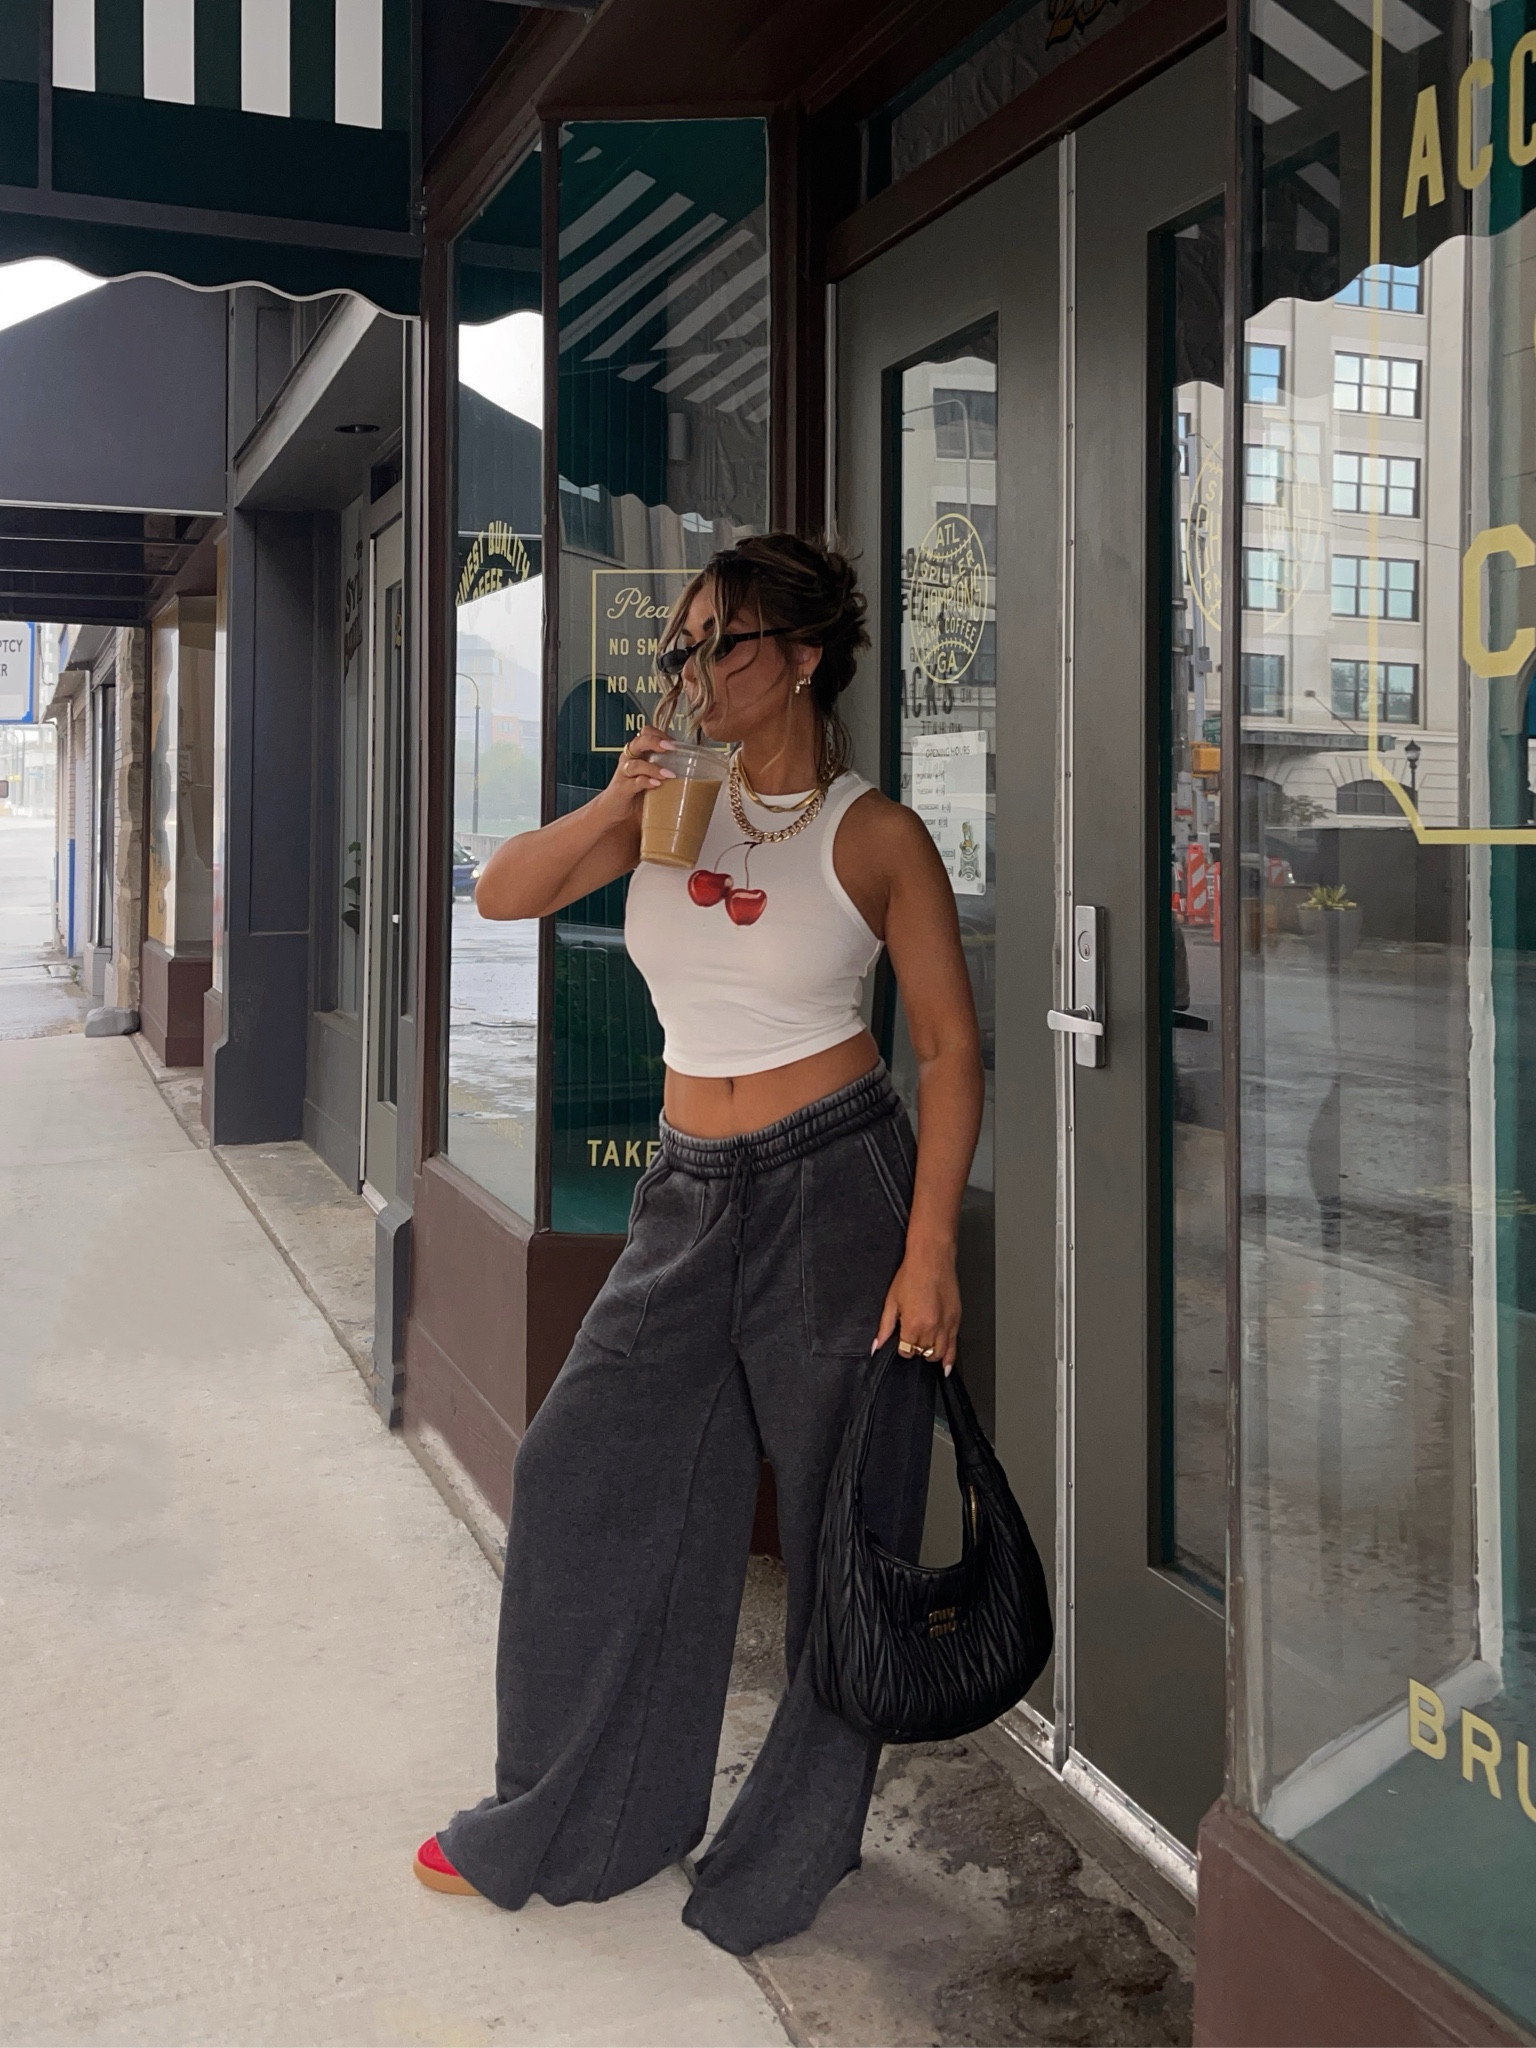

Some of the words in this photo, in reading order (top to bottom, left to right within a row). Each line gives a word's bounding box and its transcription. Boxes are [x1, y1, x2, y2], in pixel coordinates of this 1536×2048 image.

[936, 522, 960, 549] ATL
[488, 520, 530, 581] QUALITY
[921, 549, 974, 585] SPILLER
[944, 617, 976, 644] COFFEE
[609, 638, 629, 655] NO
[937, 650, 958, 673] GA
[607, 676, 627, 693] NO
[625, 713, 645, 731] NO
[587, 1139, 661, 1167] TAKE
